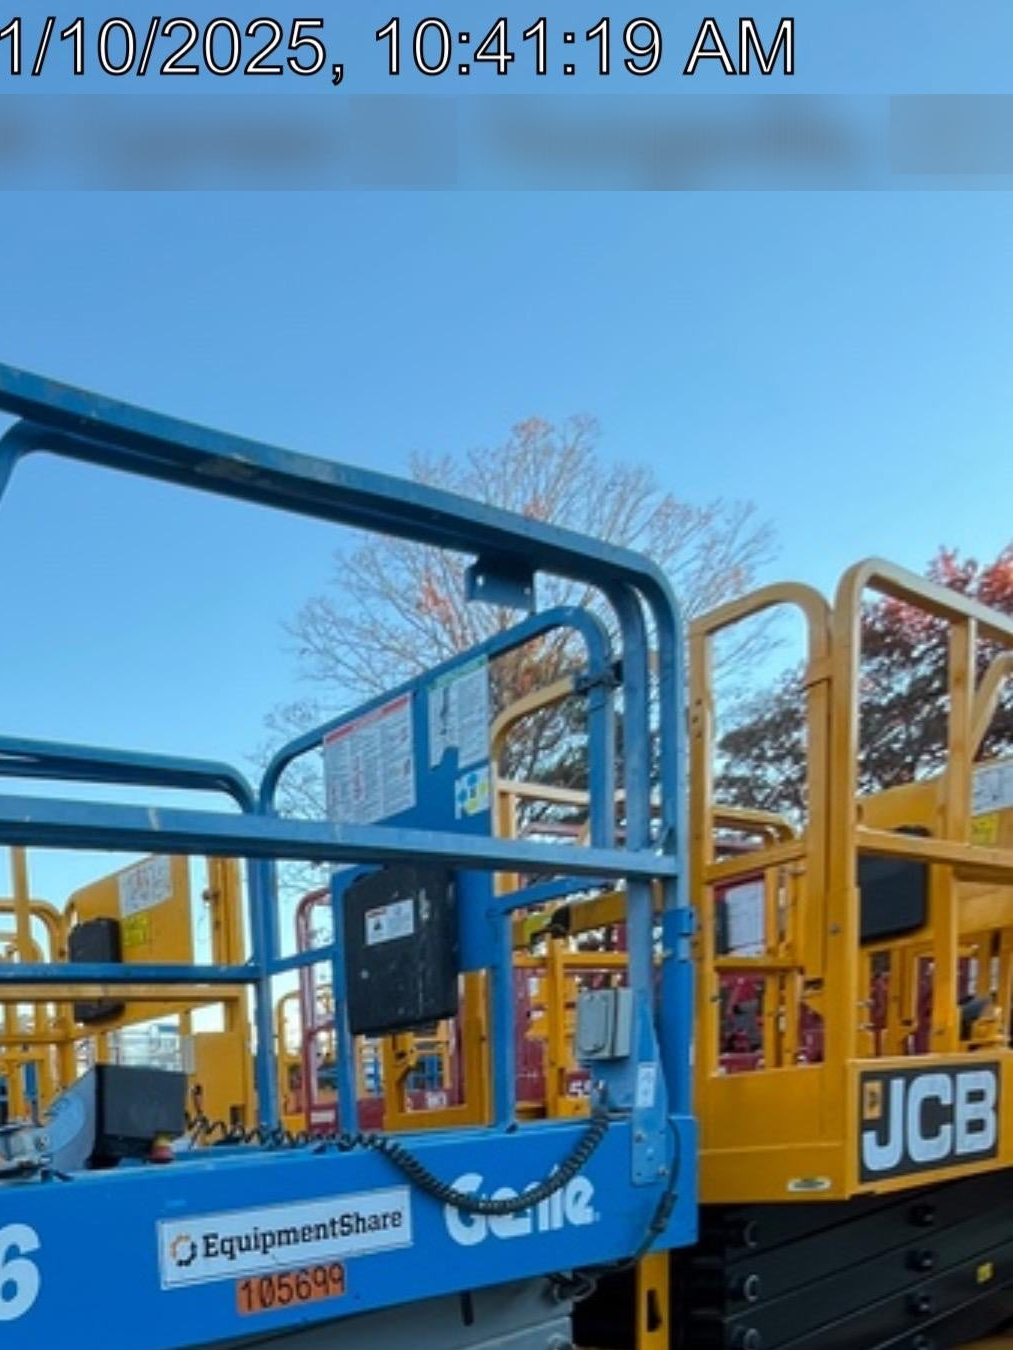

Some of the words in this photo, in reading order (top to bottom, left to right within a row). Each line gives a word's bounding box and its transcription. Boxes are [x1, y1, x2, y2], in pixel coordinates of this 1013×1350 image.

[862, 1070, 997, 1171] JCB
[202, 1210, 403, 1261] EquipmentShare
[240, 1262, 346, 1313] 105699
